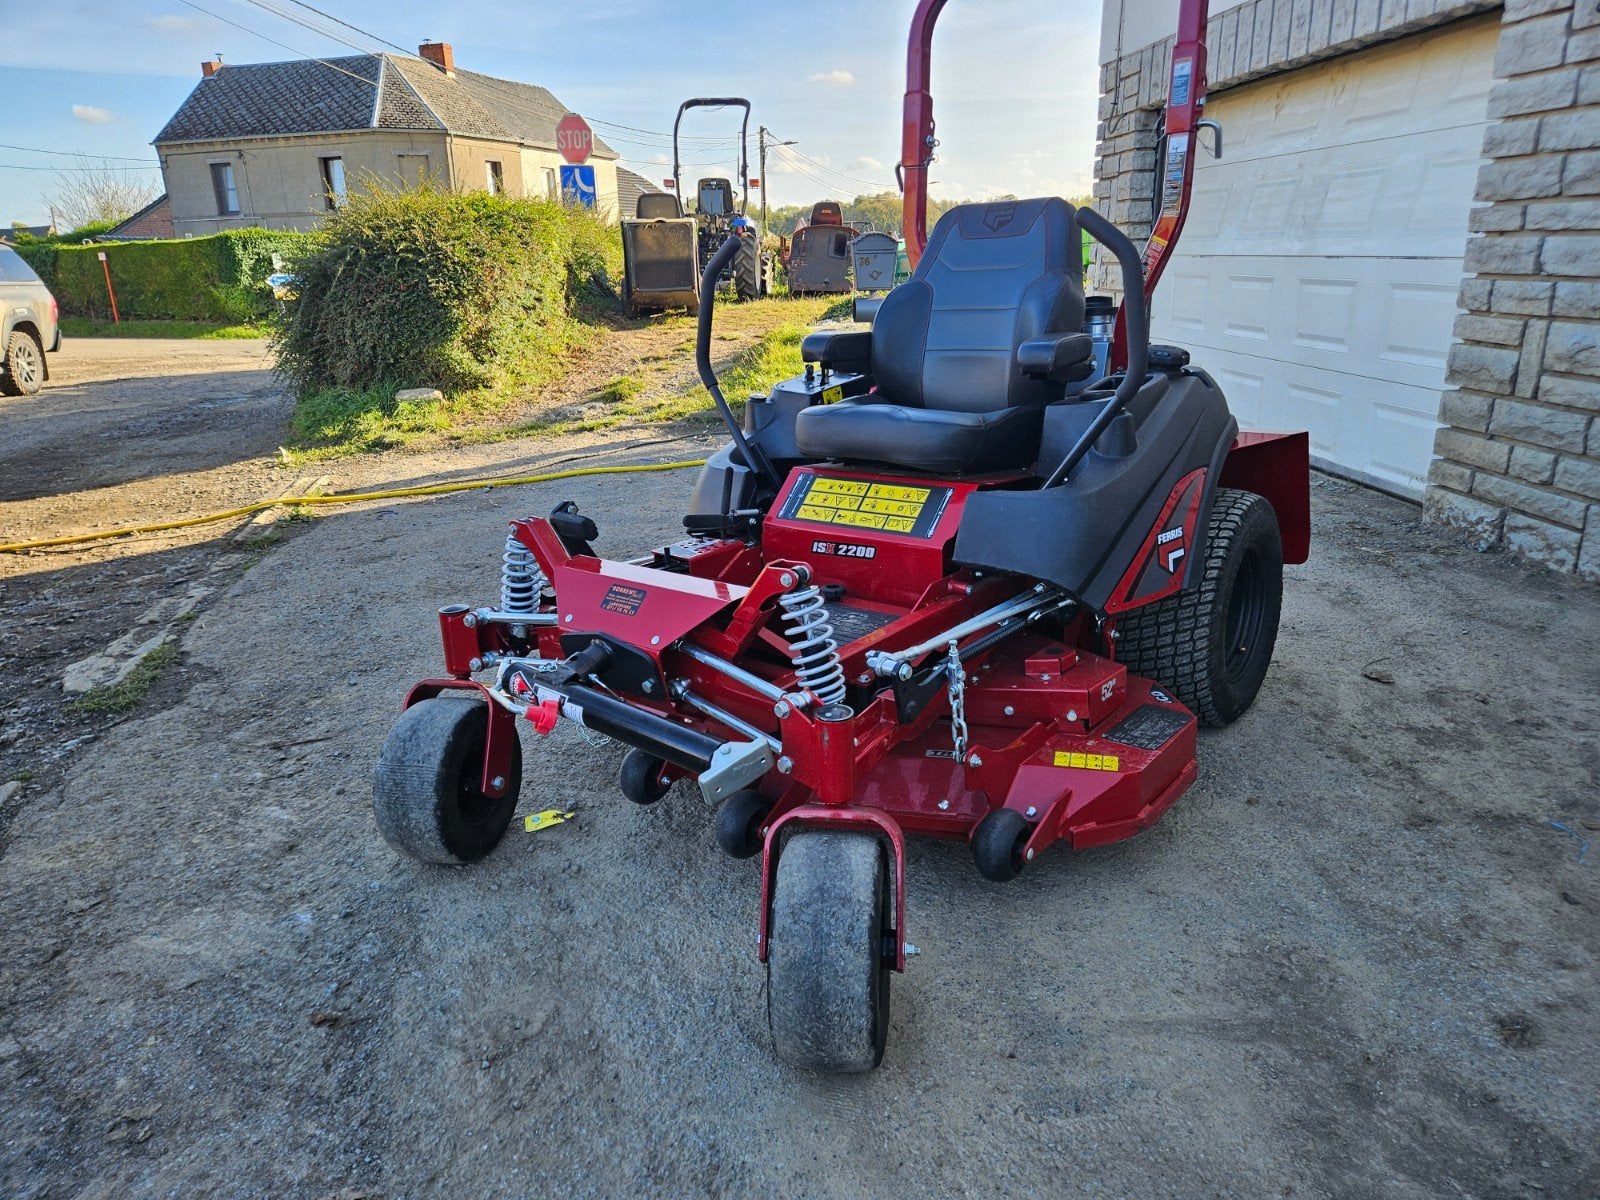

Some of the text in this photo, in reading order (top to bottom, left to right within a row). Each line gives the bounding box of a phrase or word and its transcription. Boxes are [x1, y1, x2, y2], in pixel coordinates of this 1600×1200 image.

[558, 129, 589, 149] STOP
[1157, 526, 1183, 545] FERRIS
[812, 541, 875, 558] ISX 2200
